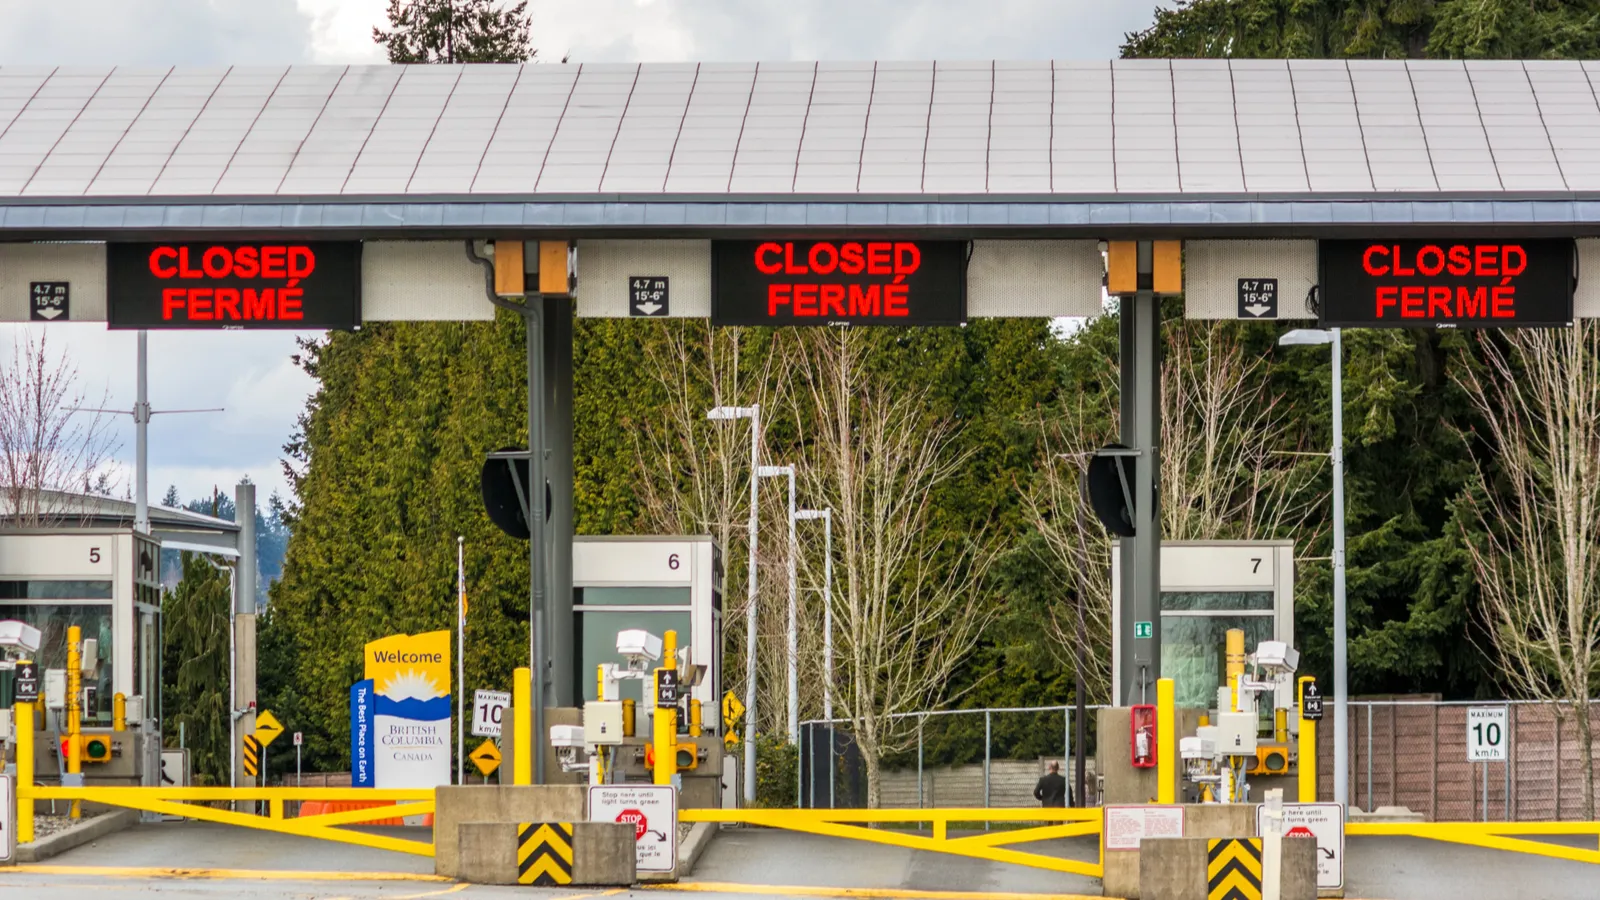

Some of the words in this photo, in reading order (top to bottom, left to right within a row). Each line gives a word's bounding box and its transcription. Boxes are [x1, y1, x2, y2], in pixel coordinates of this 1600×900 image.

[149, 246, 315, 279] CLOSED
[755, 243, 920, 275] CLOSED
[1362, 245, 1527, 277] CLOSED
[34, 285, 51, 295] 4.7
[55, 286, 66, 295] m
[633, 279, 650, 289] 4.7
[655, 280, 665, 289] m
[1242, 281, 1259, 291] 4.7
[1263, 282, 1274, 291] m
[163, 278, 304, 320] FERMÉ
[768, 275, 909, 317] FERMÉ
[1376, 277, 1515, 318] FERMÉ
[89, 547, 101, 564] 5
[668, 553, 680, 570] 6
[1250, 557, 1262, 574] 7
[374, 650, 442, 664] Welcome
[358, 688, 366, 703] The
[358, 704, 366, 723] Best
[480, 703, 503, 724] 10
[358, 724, 366, 747] Place
[390, 724, 437, 735] BRITISH
[1473, 722, 1501, 747] 10
[382, 735, 443, 746] COLUMBIA
[358, 747, 365, 759] on
[393, 751, 433, 761] CANADA
[1475, 749, 1500, 757] km/h
[358, 760, 367, 783] Earth
[621, 814, 642, 824] STOP
